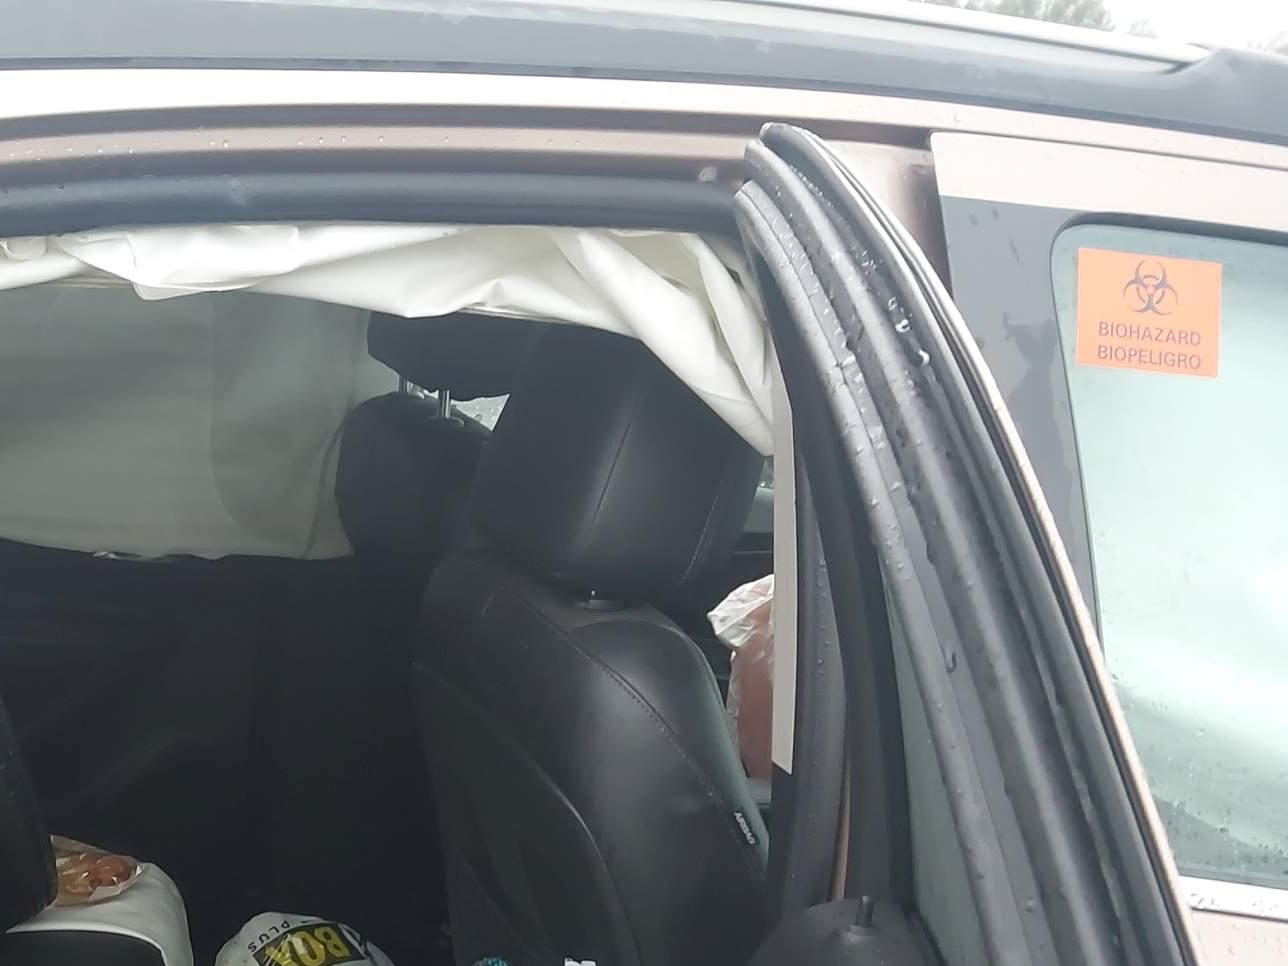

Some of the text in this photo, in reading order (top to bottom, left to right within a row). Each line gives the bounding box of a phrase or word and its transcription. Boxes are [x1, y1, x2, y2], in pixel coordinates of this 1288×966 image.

[1098, 320, 1202, 346] BIOHAZARD
[1097, 344, 1202, 370] BIOPELIGRO
[733, 811, 756, 845] AIRBAG
[247, 919, 290, 953] PLUS
